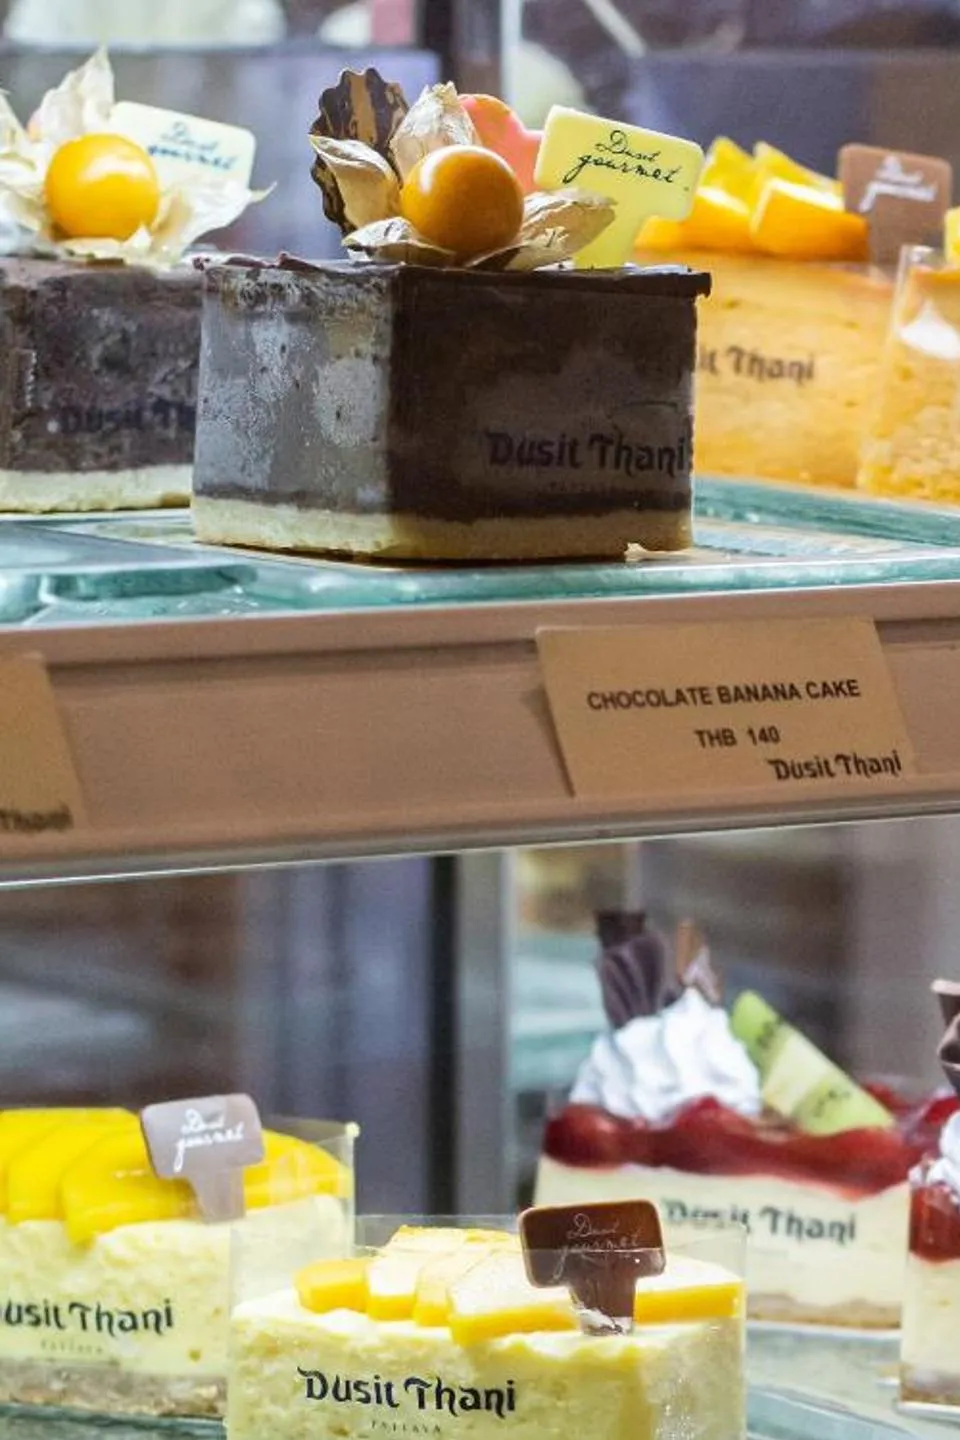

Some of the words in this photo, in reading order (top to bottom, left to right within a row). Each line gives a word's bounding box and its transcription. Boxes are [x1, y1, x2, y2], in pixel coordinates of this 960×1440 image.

[726, 344, 815, 388] Thani
[484, 426, 583, 469] Dusit
[588, 422, 687, 480] Thani
[587, 686, 713, 710] CHOCOLATE
[717, 682, 801, 705] BANANA
[805, 678, 861, 700] CAKE
[695, 728, 737, 749] THB
[746, 726, 781, 745] 140
[767, 756, 836, 781] Dusit
[834, 749, 903, 778] Thani
[758, 1203, 857, 1247] Thani
[0, 1298, 66, 1331] usit
[68, 1297, 174, 1338] Thani
[296, 1365, 401, 1409] Dusit
[403, 1374, 517, 1420] Thani
